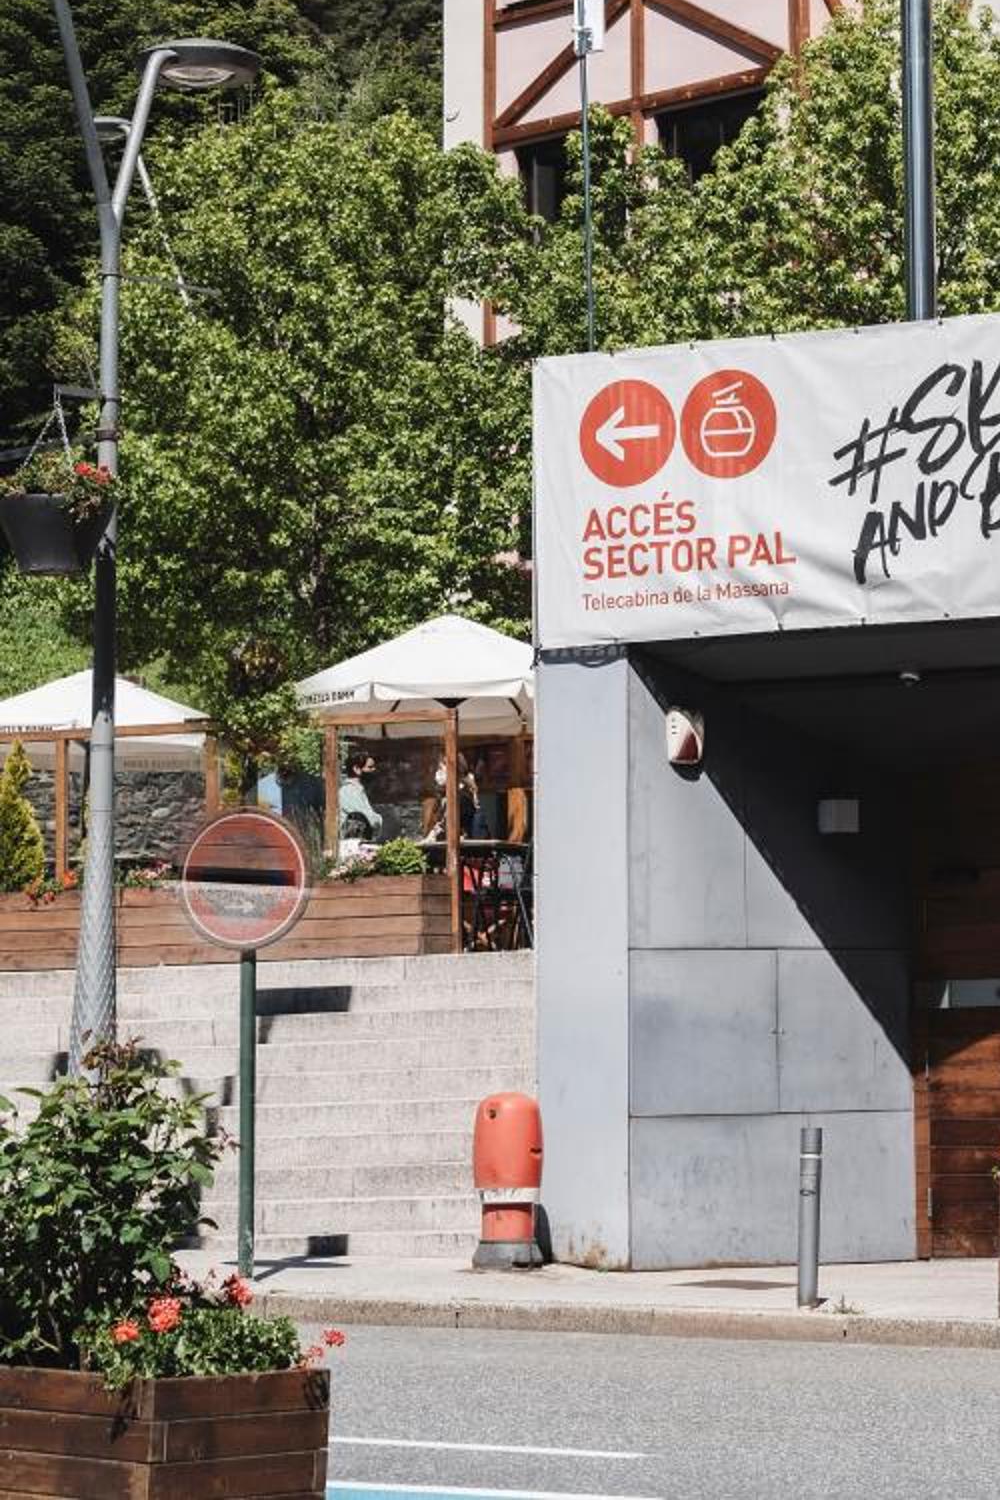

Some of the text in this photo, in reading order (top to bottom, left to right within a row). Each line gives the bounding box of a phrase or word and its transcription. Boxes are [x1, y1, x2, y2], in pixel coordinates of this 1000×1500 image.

[582, 492, 697, 543] ACCÉS
[582, 531, 797, 581] SECTOR PAL
[582, 581, 790, 611] Telecabina de la Massana
